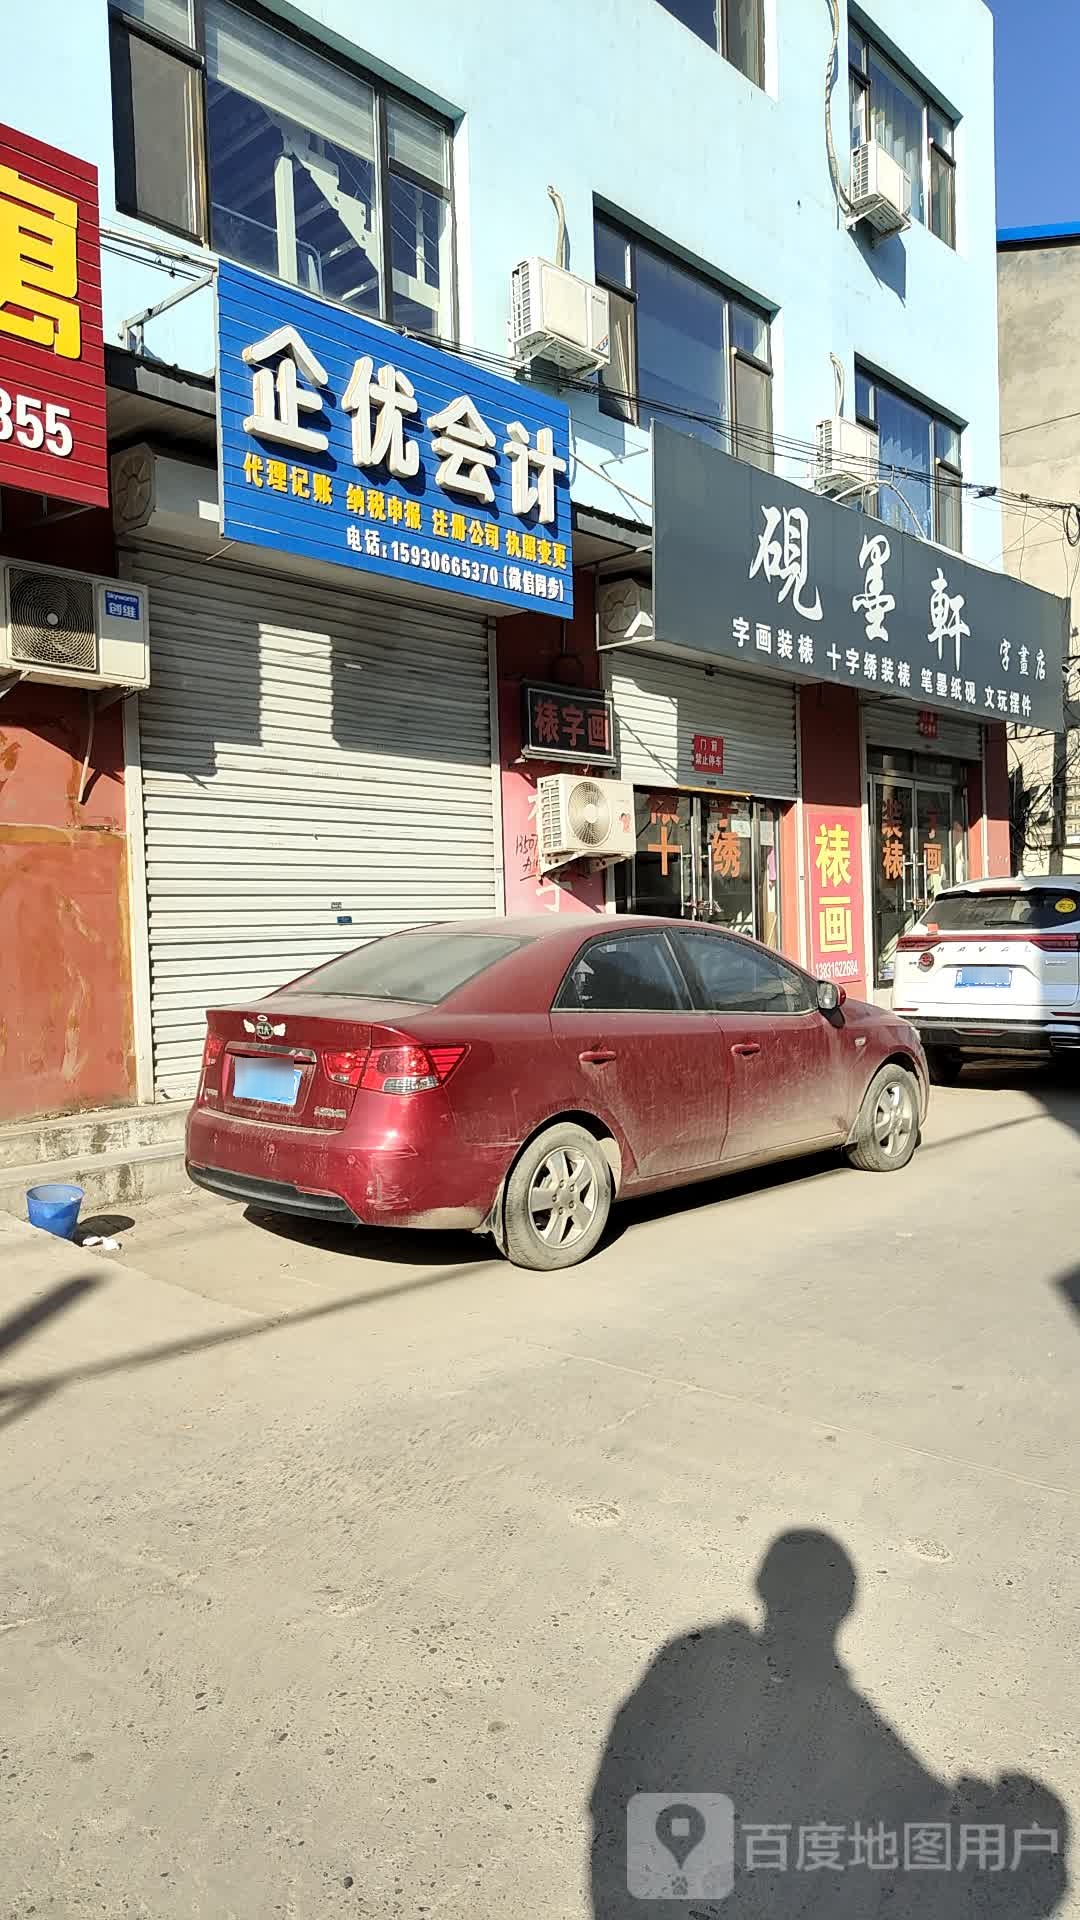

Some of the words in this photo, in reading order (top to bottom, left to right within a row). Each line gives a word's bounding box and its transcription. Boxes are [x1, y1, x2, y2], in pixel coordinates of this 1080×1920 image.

[242, 325, 567, 524] 企优会计
[243, 452, 333, 505] 代理记账
[346, 483, 421, 530] 纳税申报
[432, 509, 500, 551] 注册公司
[505, 530, 567, 570] 执照变更
[535, 700, 610, 751] 裱字画
[732, 617, 814, 664] 字画装裱
[827, 644, 911, 688] 十字绣装裱
[921, 668, 976, 704] 笔墨纸砚
[984, 686, 1032, 717] 文玩摆件
[815, 824, 854, 955] 裱画
